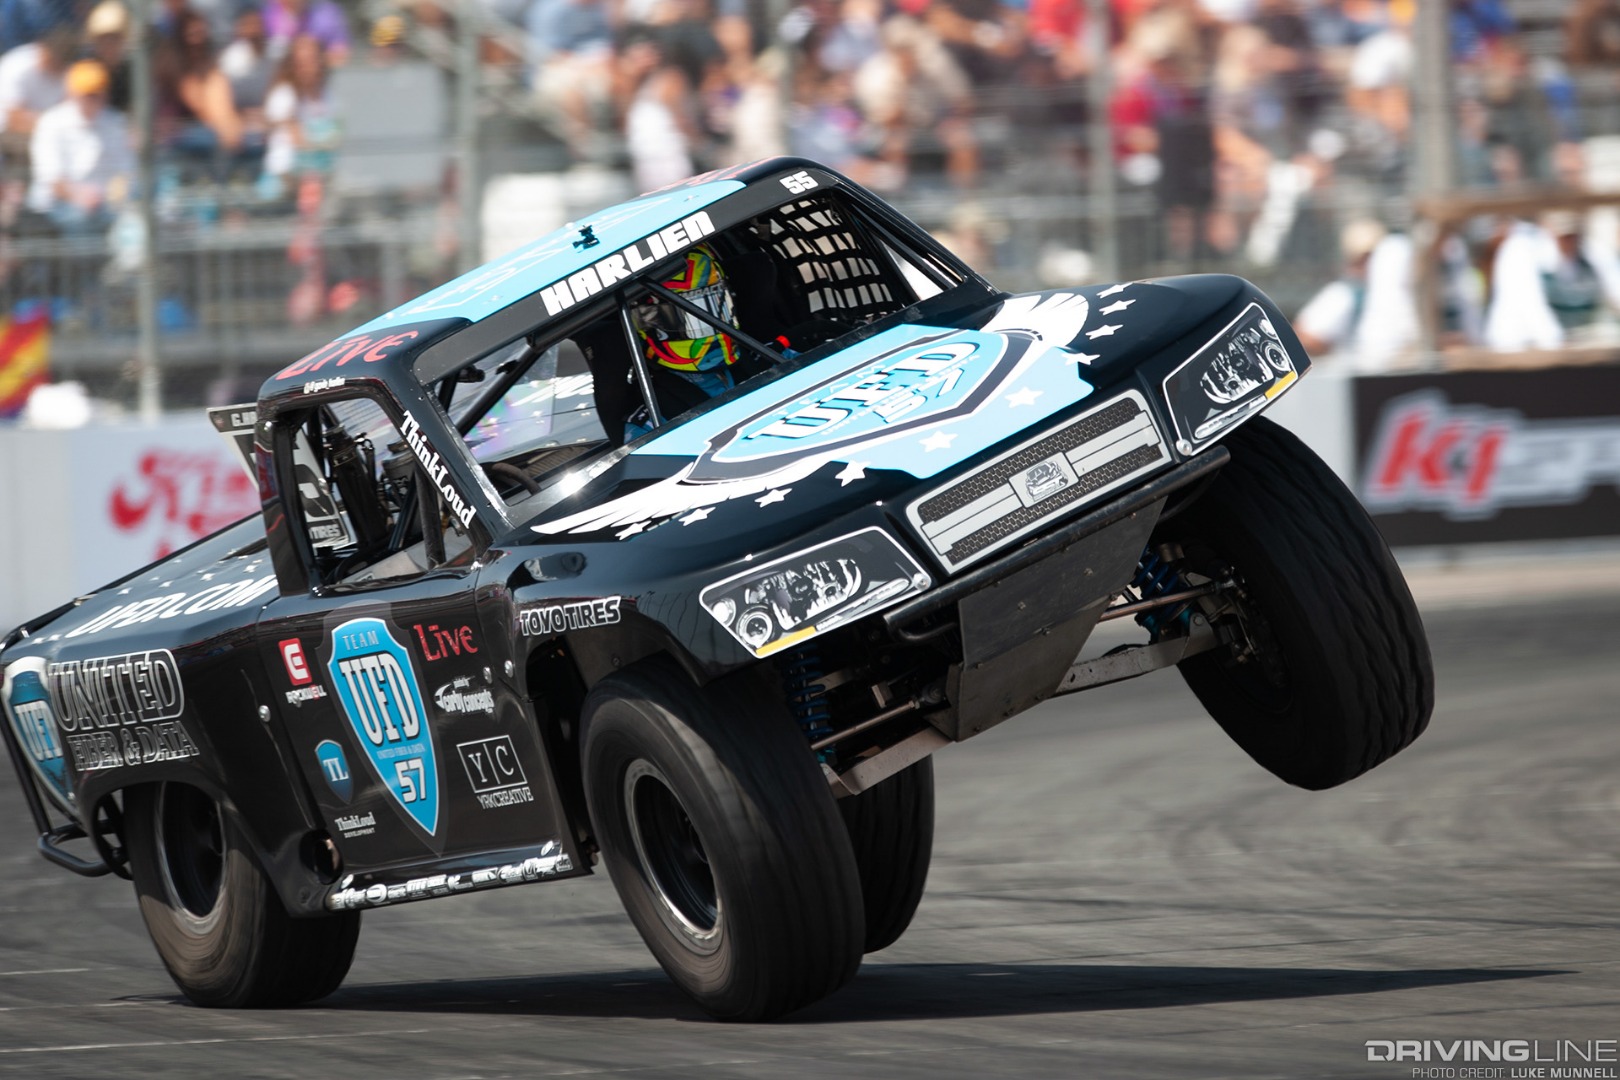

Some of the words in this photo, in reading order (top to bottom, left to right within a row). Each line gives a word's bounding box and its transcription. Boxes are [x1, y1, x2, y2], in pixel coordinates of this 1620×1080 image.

[779, 170, 819, 194] 55
[539, 210, 716, 316] HARLIEN
[741, 341, 980, 440] UFD
[400, 409, 477, 529] ThinkLoud
[519, 606, 567, 637] TOYO
[563, 596, 622, 631] TIRES
[342, 630, 380, 651] TEAM
[48, 648, 185, 732] UNITED
[338, 652, 421, 746] UFD
[135, 720, 200, 764] DATA
[322, 757, 349, 782] TL
[394, 757, 427, 804] 57
[476, 786, 535, 809] YRKCREATIVE
[334, 811, 377, 831] ThinkLoud
